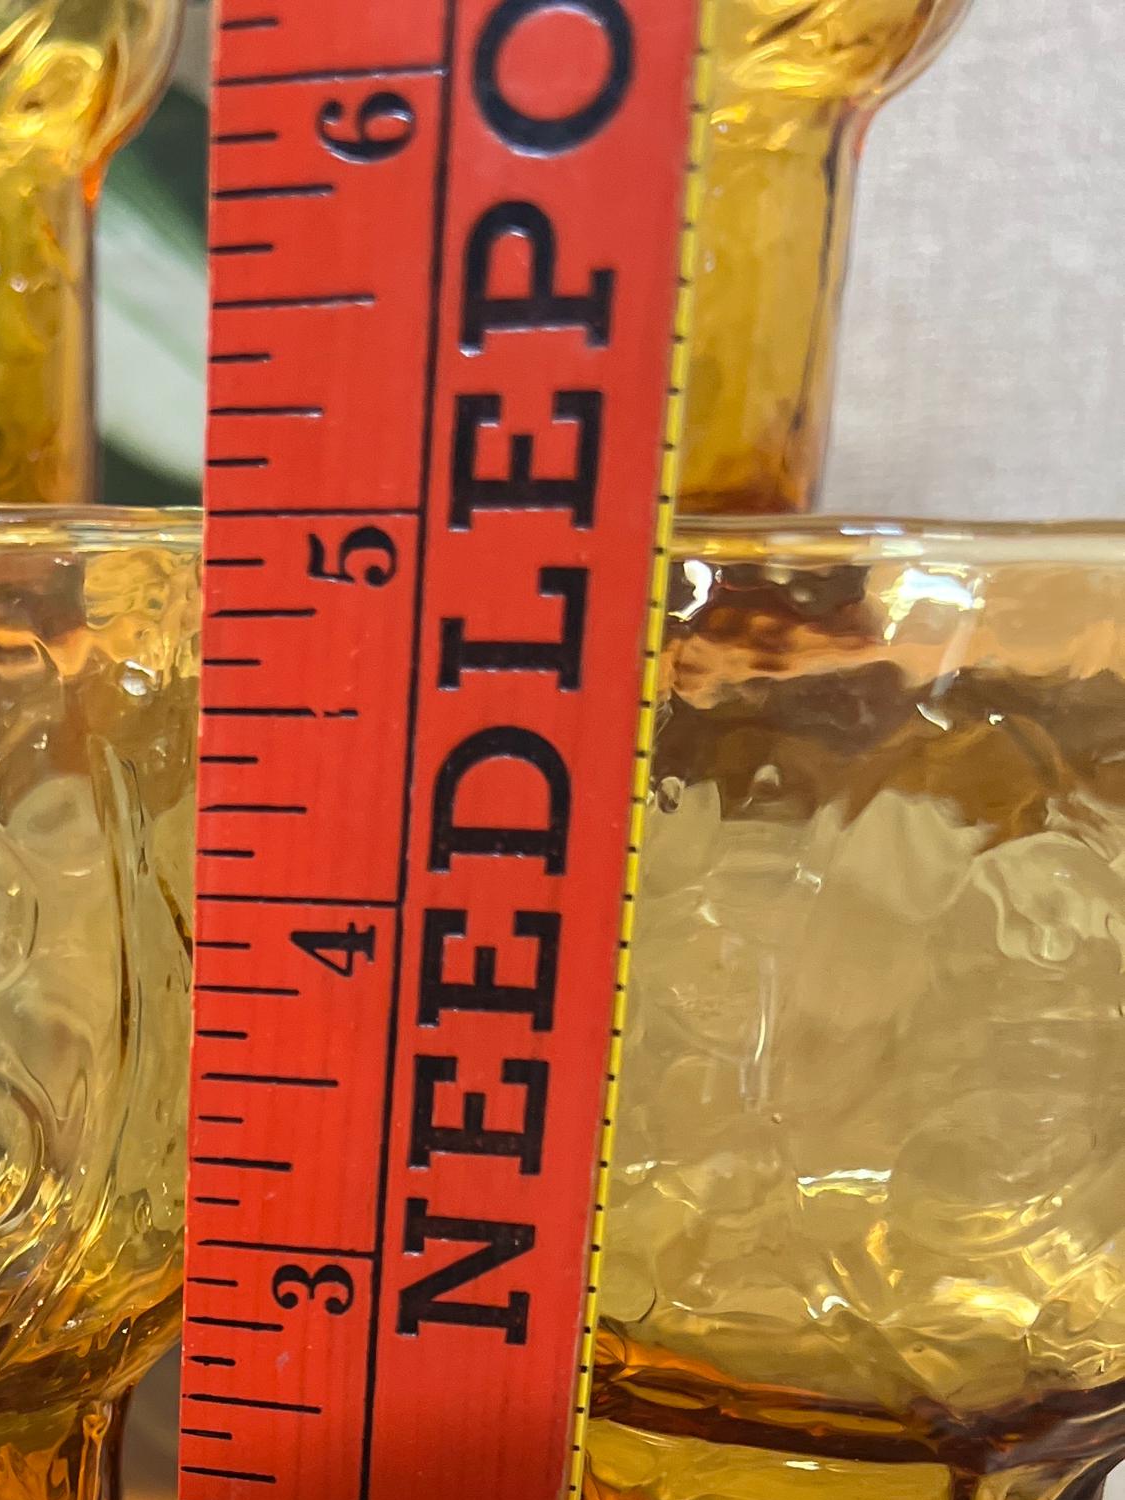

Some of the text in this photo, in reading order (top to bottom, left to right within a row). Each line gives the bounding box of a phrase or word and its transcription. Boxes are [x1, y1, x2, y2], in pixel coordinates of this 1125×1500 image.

[315, 91, 416, 164] 6
[307, 526, 398, 588] 5
[395, 0, 635, 1345] NEEDLEPO
[289, 921, 376, 978] 4
[271, 1263, 355, 1316] 3
